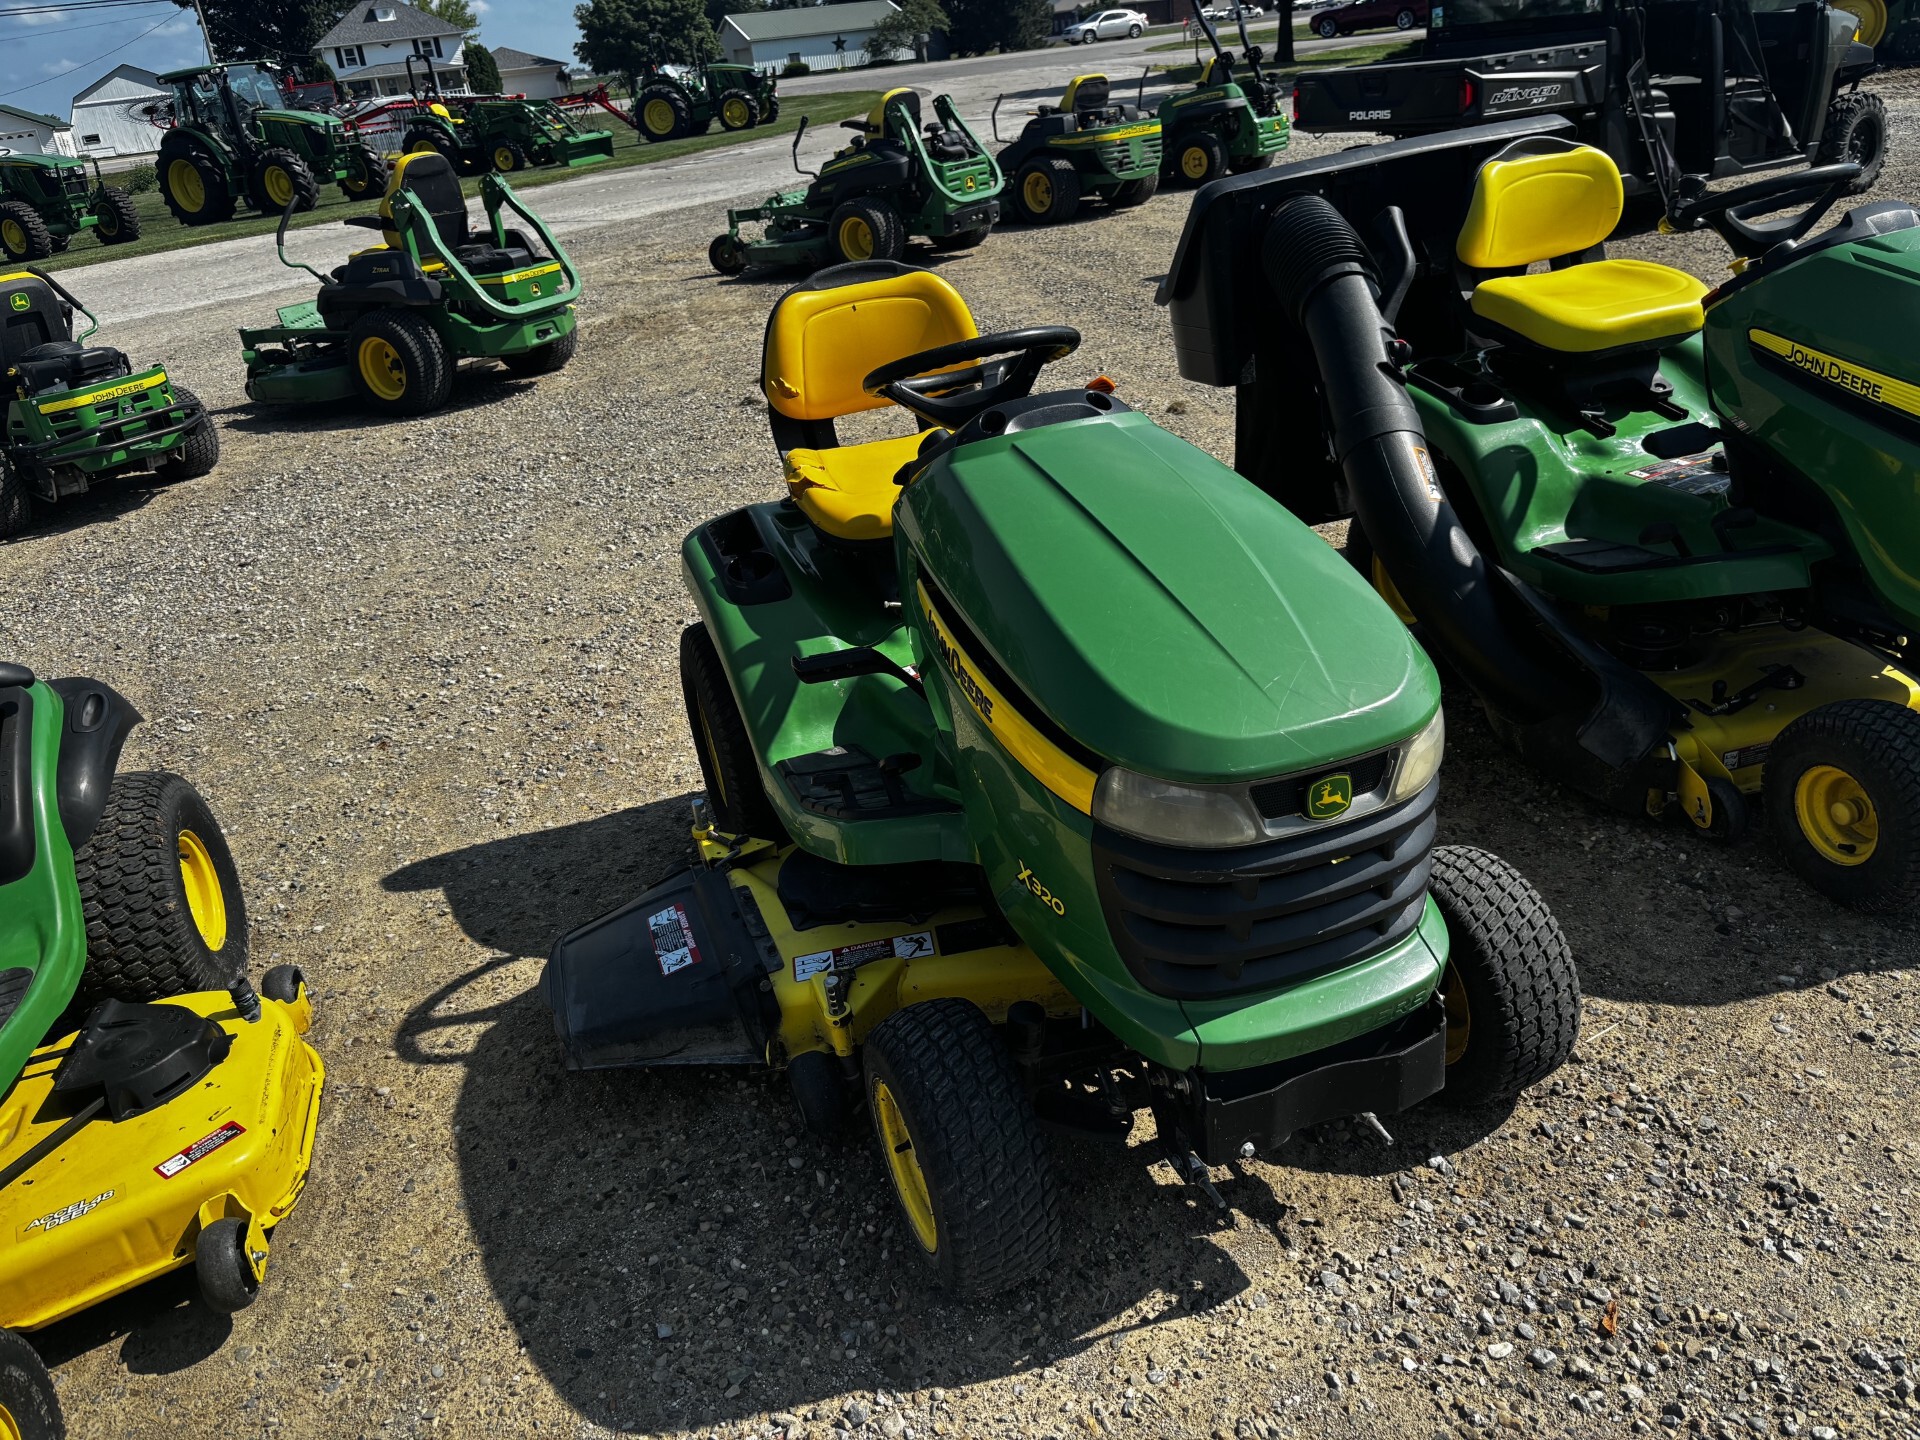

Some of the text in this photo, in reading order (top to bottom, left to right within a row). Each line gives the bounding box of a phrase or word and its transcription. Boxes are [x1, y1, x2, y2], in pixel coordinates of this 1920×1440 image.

[1192, 27, 1202, 36] 10
[1489, 84, 1562, 105] RANGER
[1349, 109, 1391, 121] POLARIS
[1785, 343, 1883, 402] JOHN DEERE
[92, 382, 145, 403] JOHN DEERE
[951, 648, 993, 723] DEERE
[1017, 859, 1065, 915] X320
[850, 940, 885, 951] DANGER
[23, 1199, 90, 1233] ACCEL
[43, 1203, 97, 1232] DEEP
